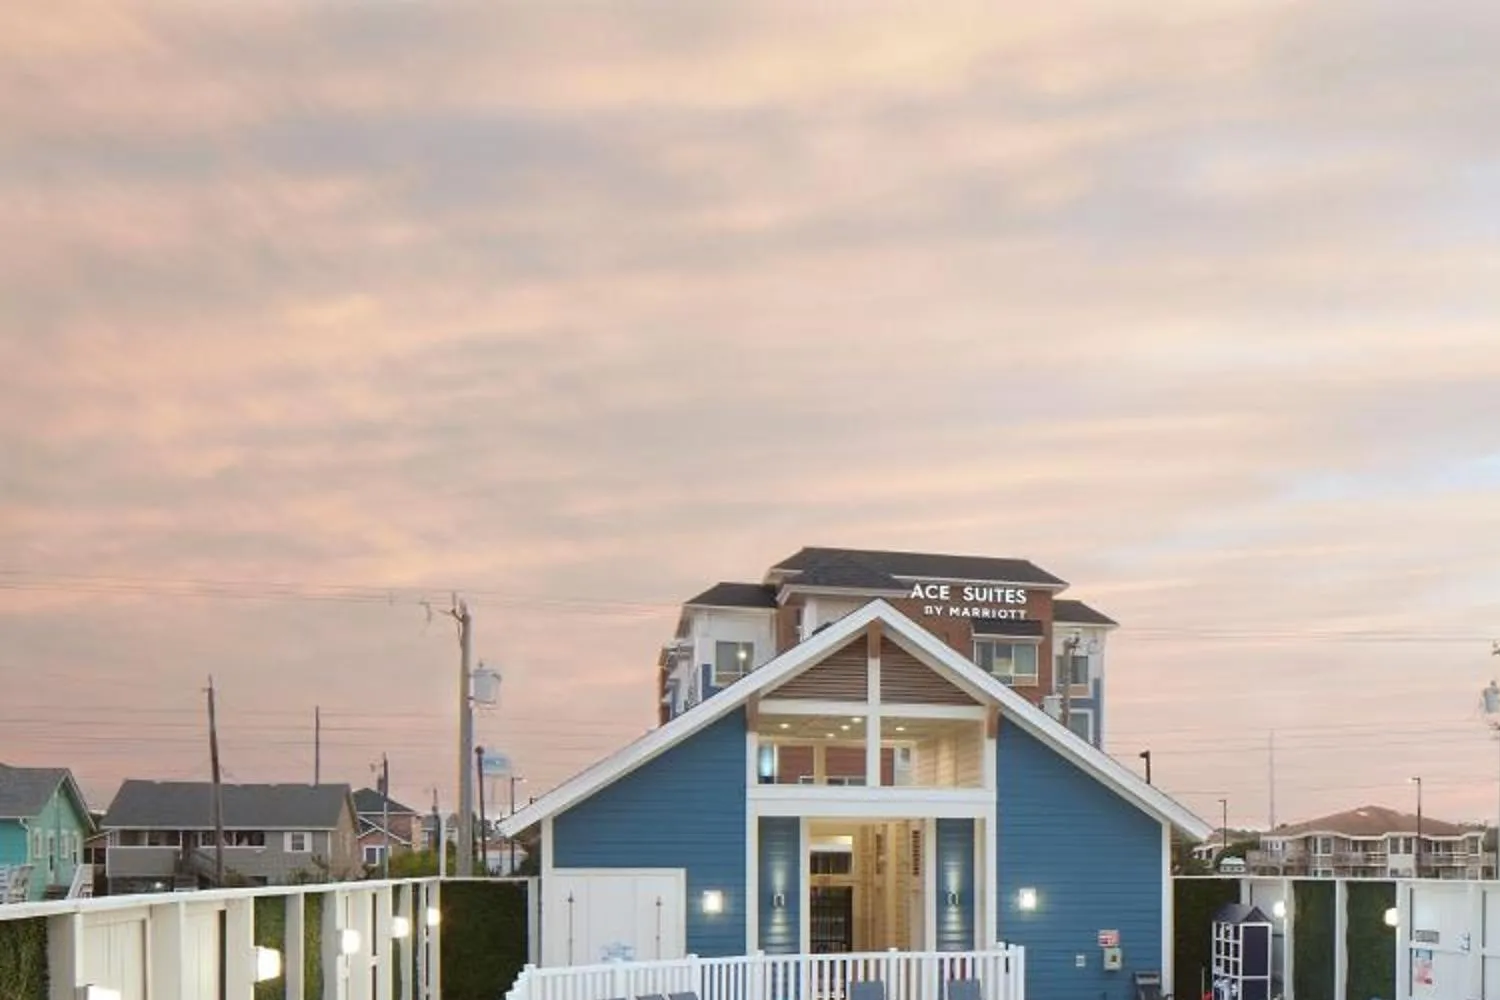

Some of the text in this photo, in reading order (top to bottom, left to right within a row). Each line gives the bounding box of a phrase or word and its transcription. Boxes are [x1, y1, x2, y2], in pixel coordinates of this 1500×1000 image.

[911, 583, 1027, 604] ACE SUITES
[949, 605, 1026, 619] MARRIOTT
